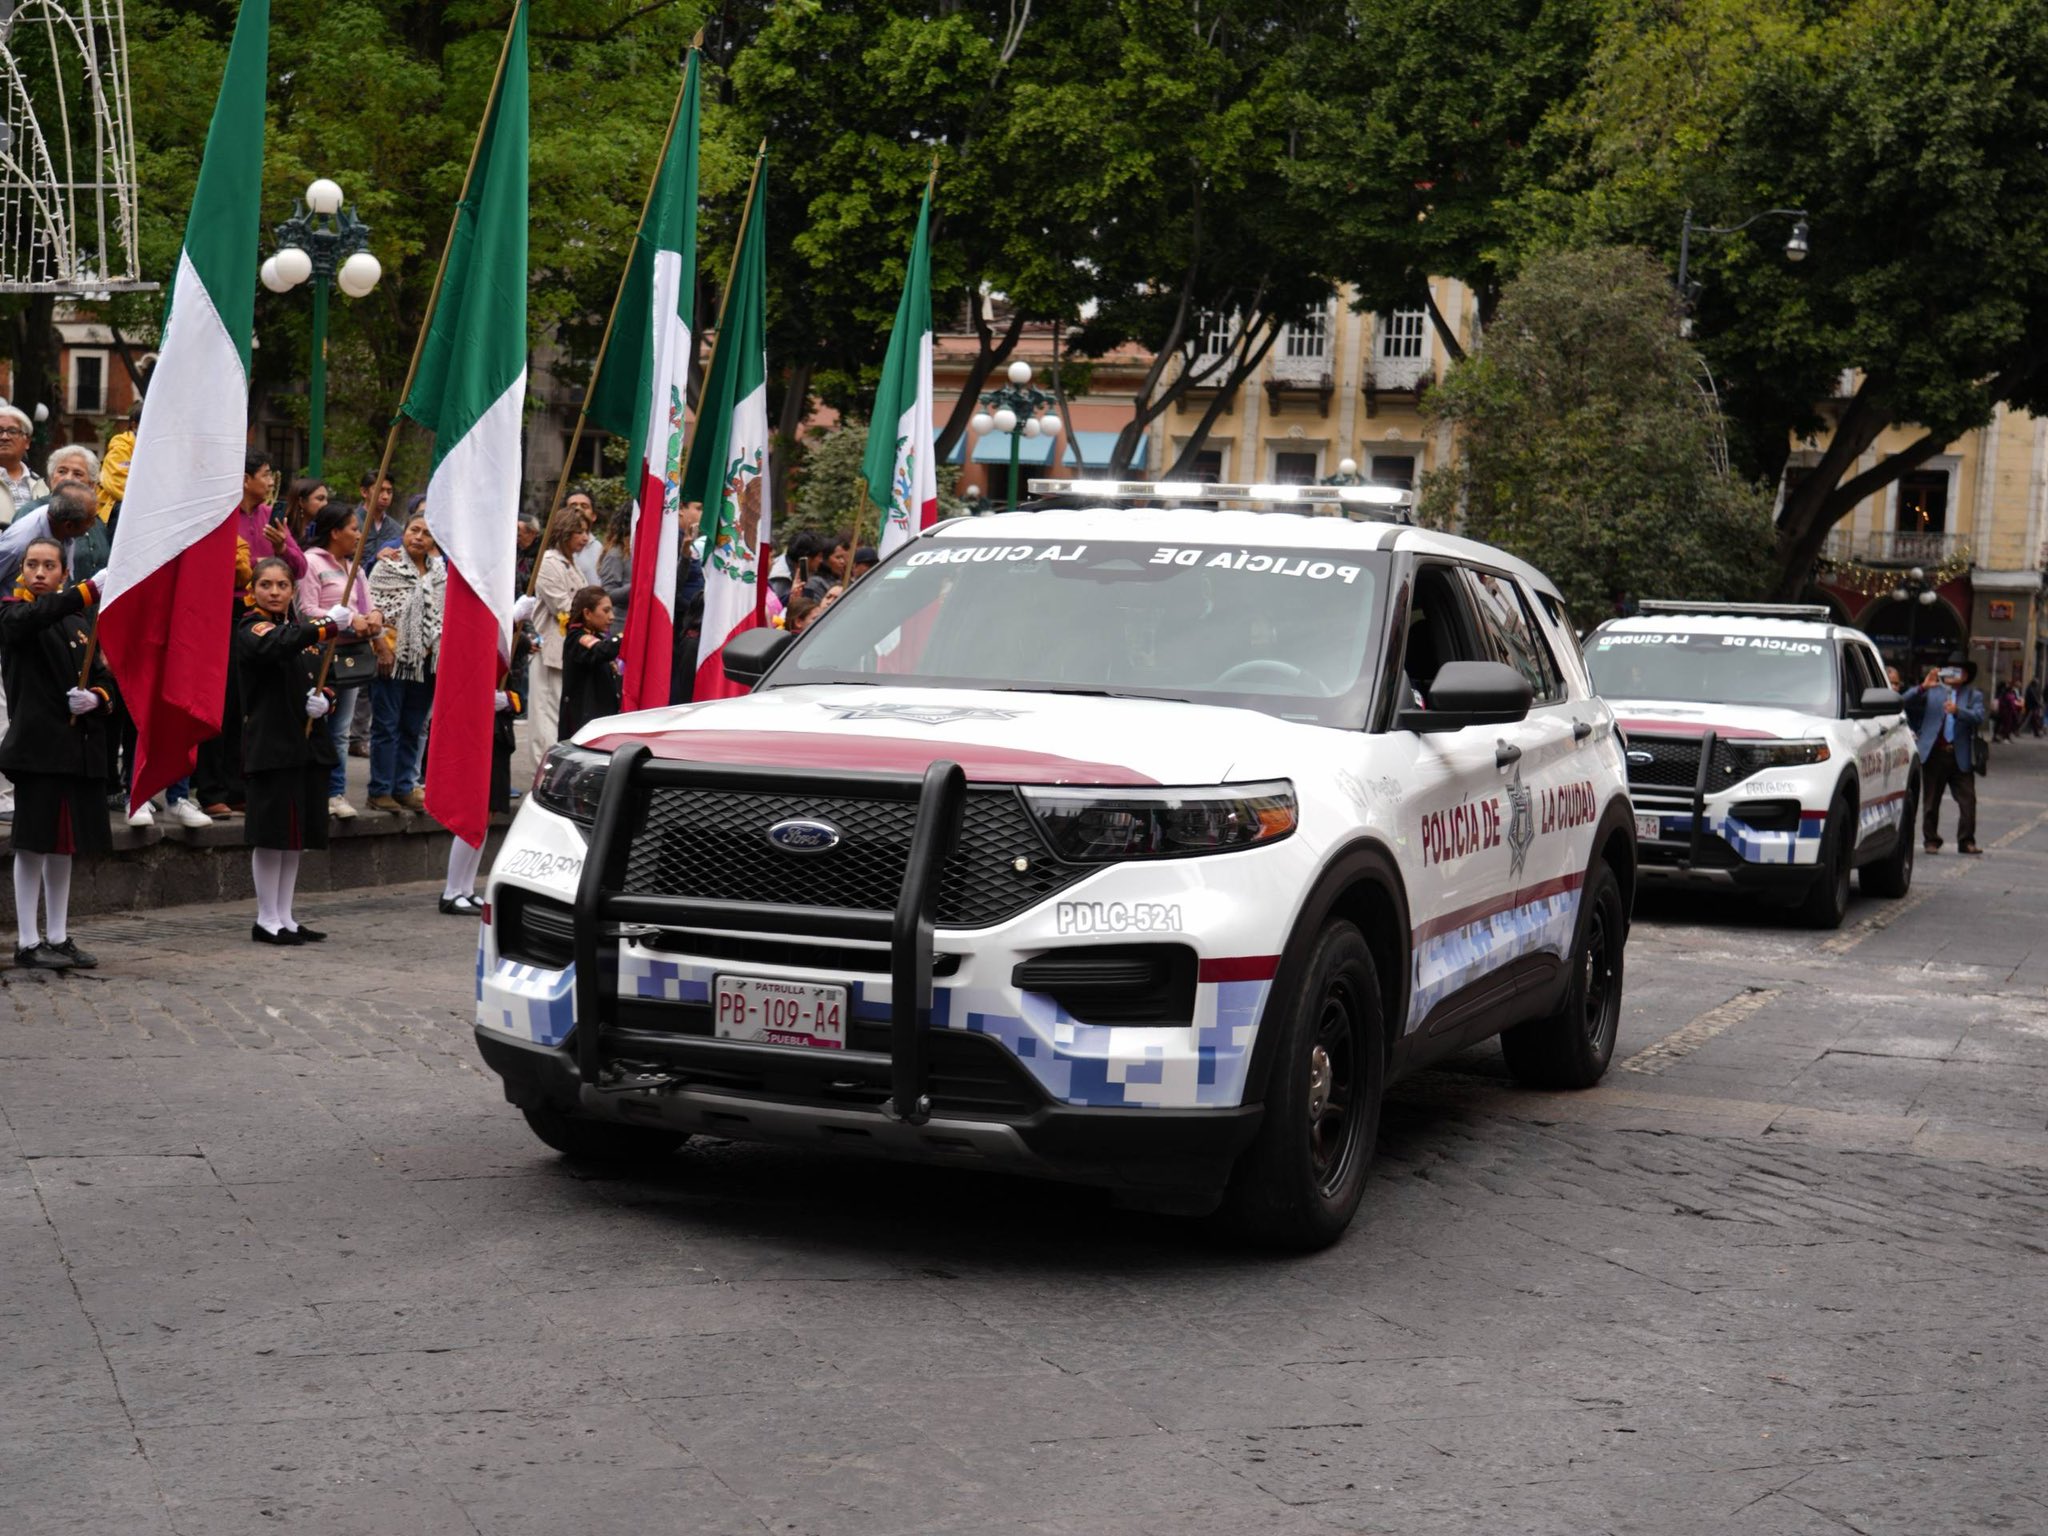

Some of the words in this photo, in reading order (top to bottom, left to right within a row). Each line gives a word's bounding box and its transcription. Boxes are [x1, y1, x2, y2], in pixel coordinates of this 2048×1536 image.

[1541, 787, 1555, 835] LA
[1557, 780, 1596, 831] CIUDAD
[782, 826, 822, 845] Ford
[1421, 791, 1480, 868] POLICÍA
[1480, 798, 1501, 850] DE
[1056, 901, 1183, 935] PDLC-521
[755, 982, 806, 996] PATRULLA
[719, 992, 840, 1033] PB-109-A4
[770, 1033, 810, 1047] PUEBLA
